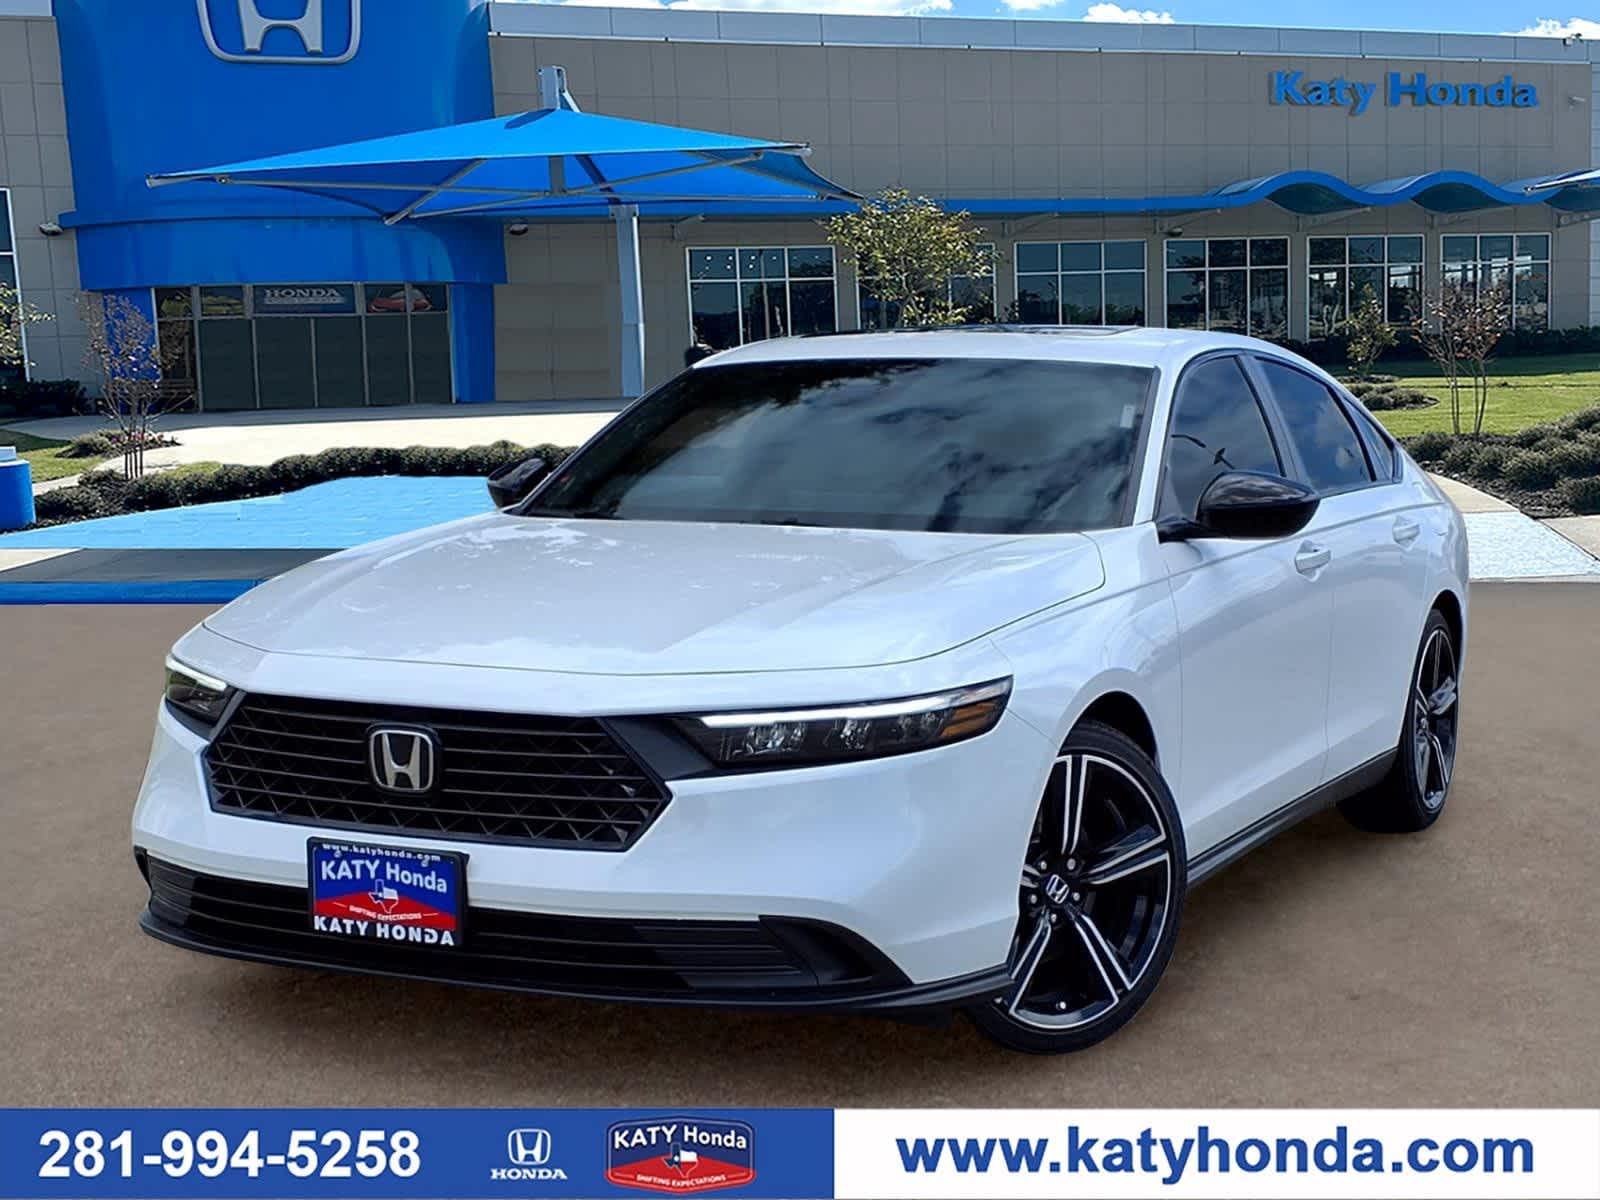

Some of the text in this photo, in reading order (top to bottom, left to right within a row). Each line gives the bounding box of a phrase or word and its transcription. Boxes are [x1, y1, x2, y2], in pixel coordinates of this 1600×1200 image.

[1270, 70, 1539, 116] Katy Honda
[264, 287, 341, 297] HONDA
[321, 859, 448, 893] KATY Honda
[313, 915, 455, 947] KATY HONDA
